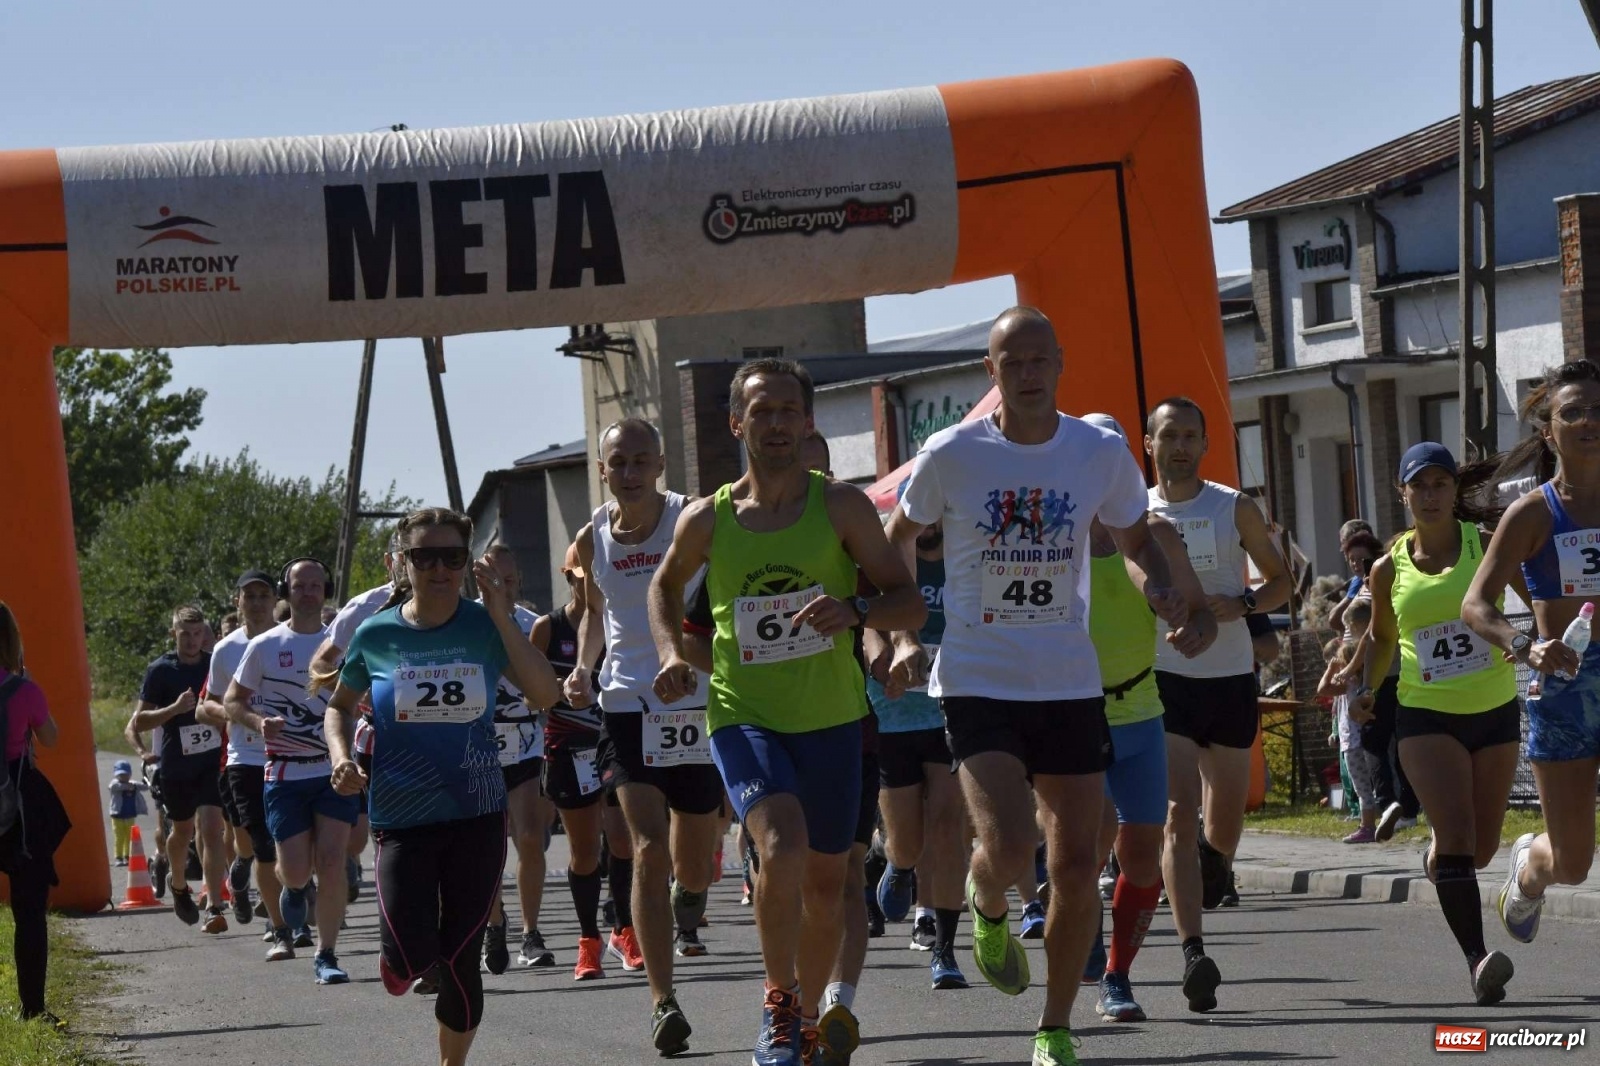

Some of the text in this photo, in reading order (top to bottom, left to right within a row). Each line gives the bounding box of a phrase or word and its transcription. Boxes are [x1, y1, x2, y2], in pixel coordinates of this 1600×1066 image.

[742, 180, 902, 202] Elektroniczny pomiar czasu
[741, 199, 911, 232] ZmierzymyCzas.pl
[323, 170, 626, 302] META
[116, 255, 239, 275] MARATONY
[116, 276, 241, 295] POLSKIE.PL
[1562, 533, 1600, 547] COLOU
[989, 564, 1067, 577] COLOUR RUN
[1002, 580, 1053, 606] 48
[741, 599, 789, 612] COLOUR
[757, 609, 803, 641] 67
[1418, 624, 1456, 640] COLOUR
[1433, 633, 1473, 660] 43
[401, 667, 478, 680] COLOUR RUN
[416, 680, 466, 707] 28
[647, 713, 705, 723] COLOUR RU
[190, 729, 212, 745] 39
[660, 724, 699, 749] 30
